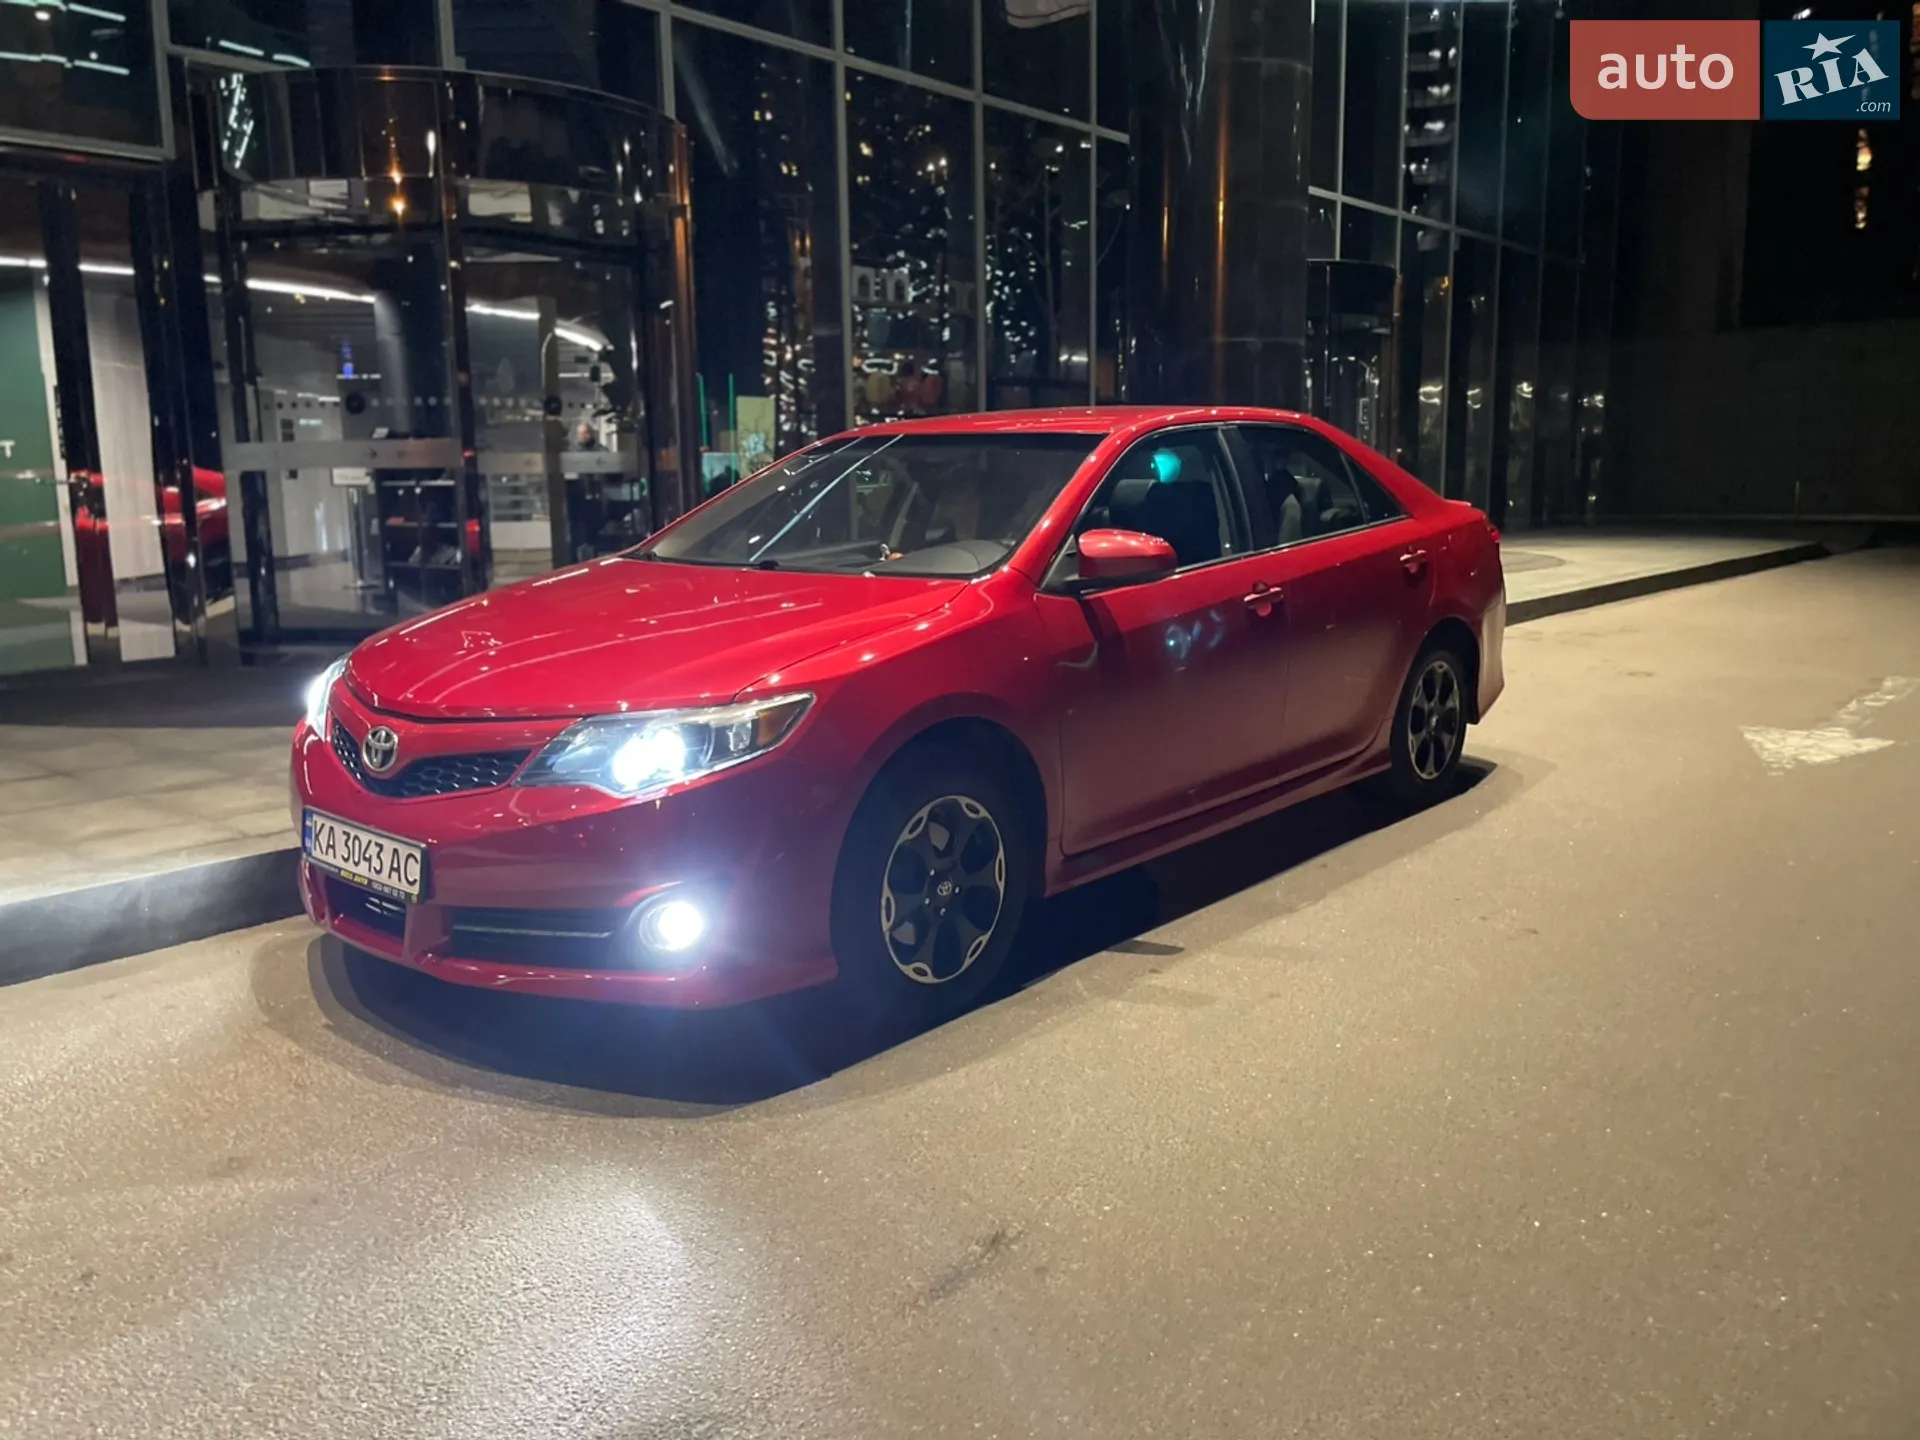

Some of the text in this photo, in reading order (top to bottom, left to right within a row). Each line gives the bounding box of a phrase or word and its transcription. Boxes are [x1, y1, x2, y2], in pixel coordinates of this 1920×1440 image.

[314, 820, 419, 886] KA 3043 AC
